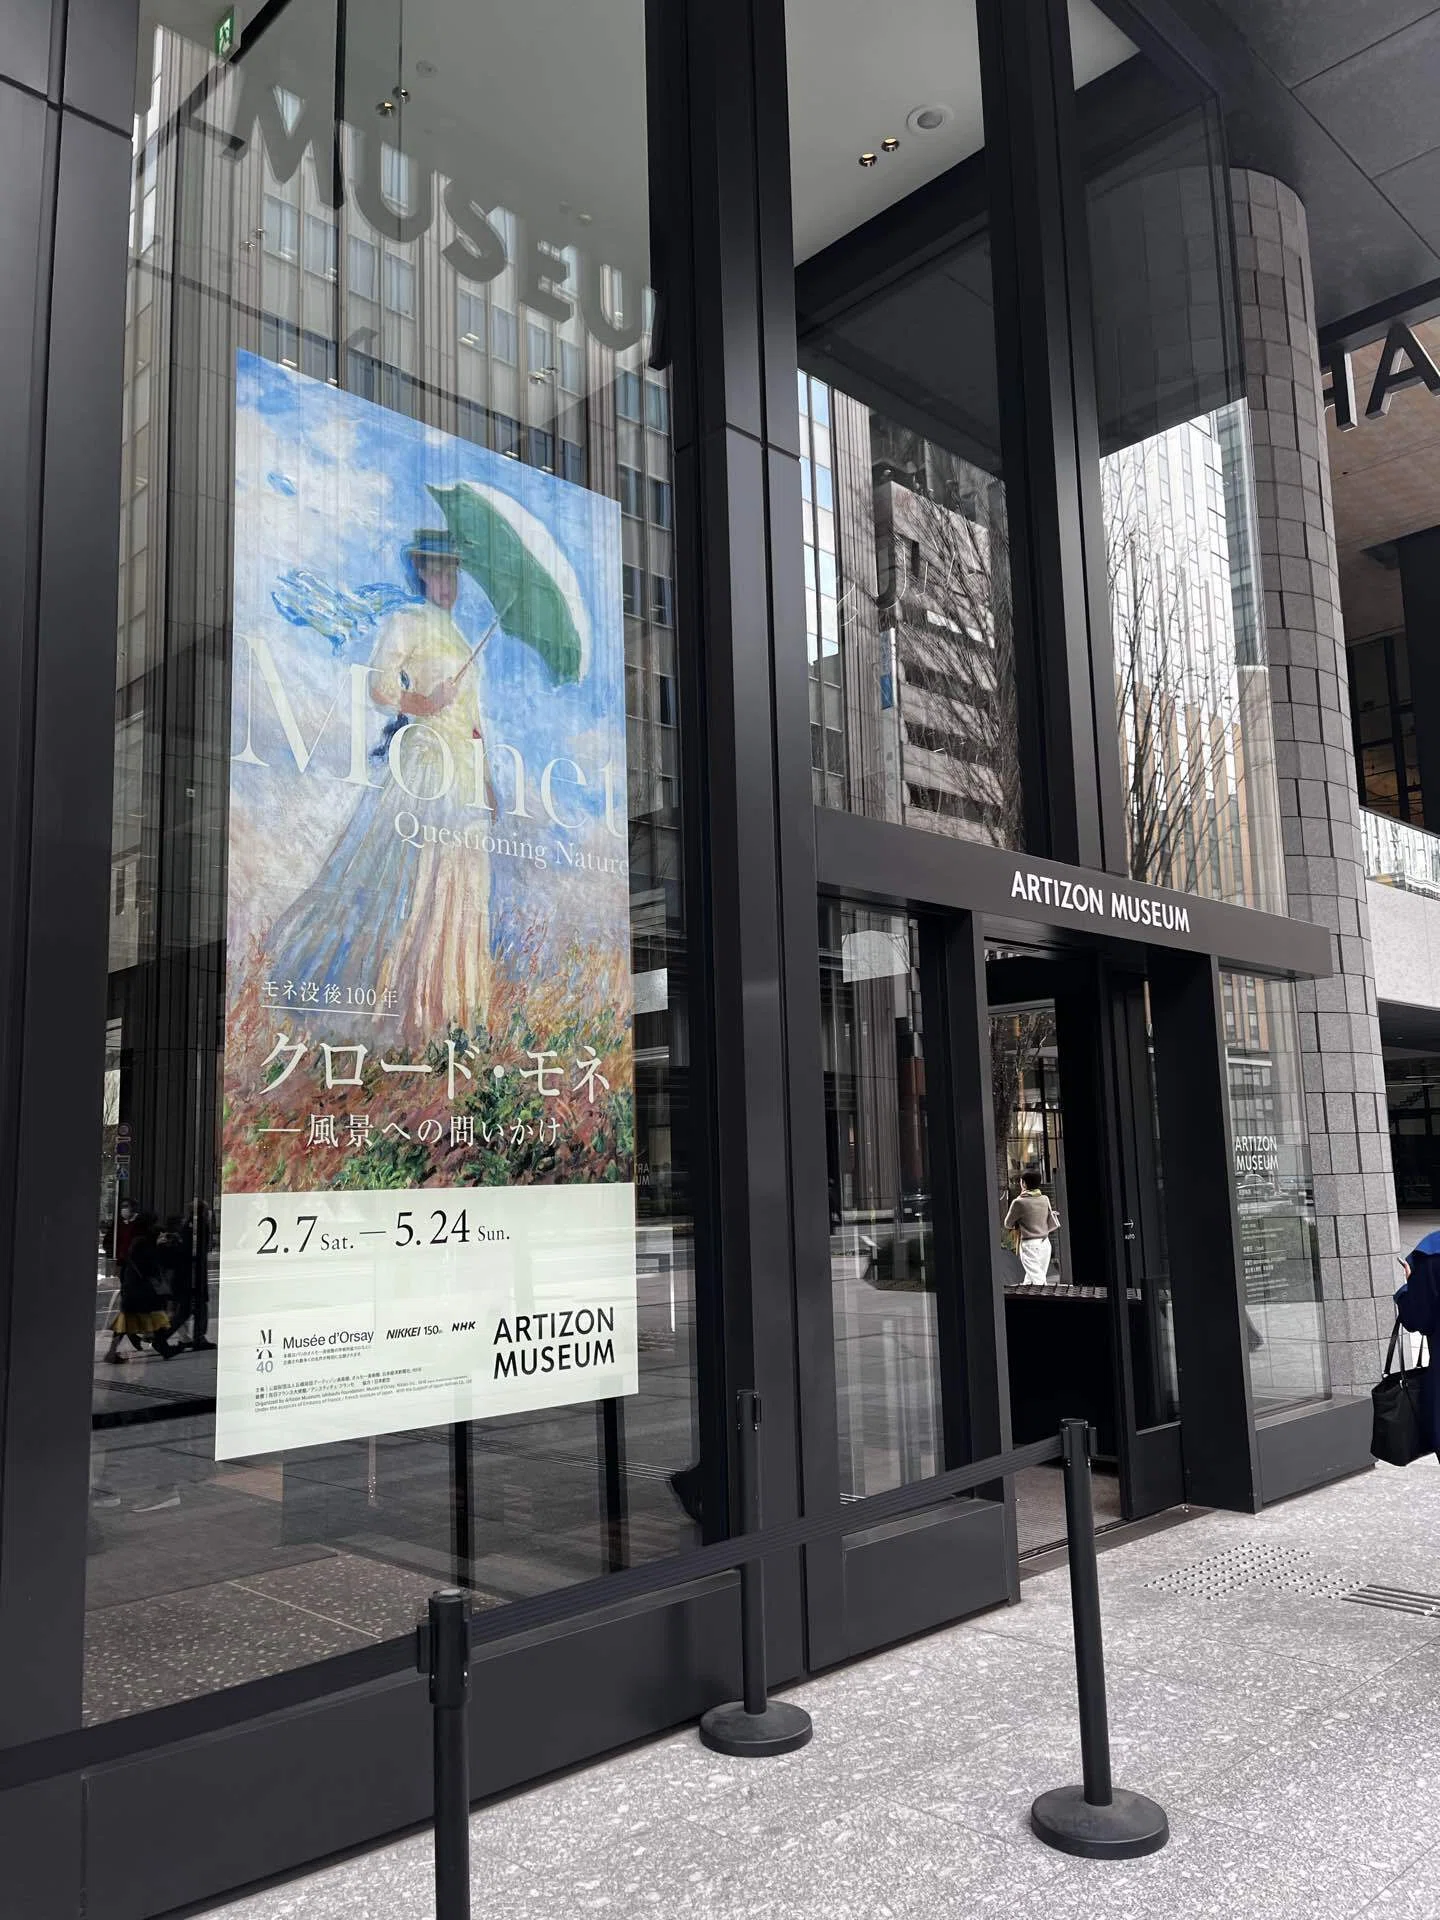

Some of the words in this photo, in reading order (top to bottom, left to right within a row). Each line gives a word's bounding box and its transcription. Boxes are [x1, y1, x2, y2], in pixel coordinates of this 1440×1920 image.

[230, 633, 628, 839] Monet
[394, 811, 547, 870] Questioning
[1011, 870, 1104, 916] ARTIZON
[1111, 892, 1190, 933] MUSEUM
[261, 980, 398, 1009] モネ没後100年
[259, 1032, 610, 1104] クロード・モネ
[1235, 1135, 1278, 1152] ARTIZON
[1236, 1153, 1279, 1172] MUSEUM
[256, 1214, 318, 1256] 2.7
[320, 1233, 354, 1252] Sat.
[395, 1208, 471, 1248] 5.24
[477, 1225, 511, 1243] Sun.
[282, 1334, 326, 1350] Musée
[386, 1326, 421, 1340] NIKKEI
[451, 1321, 476, 1332] NHK
[494, 1306, 615, 1346] ARTIZON
[255, 1360, 274, 1374] 40
[494, 1339, 616, 1380] MUSEUM
